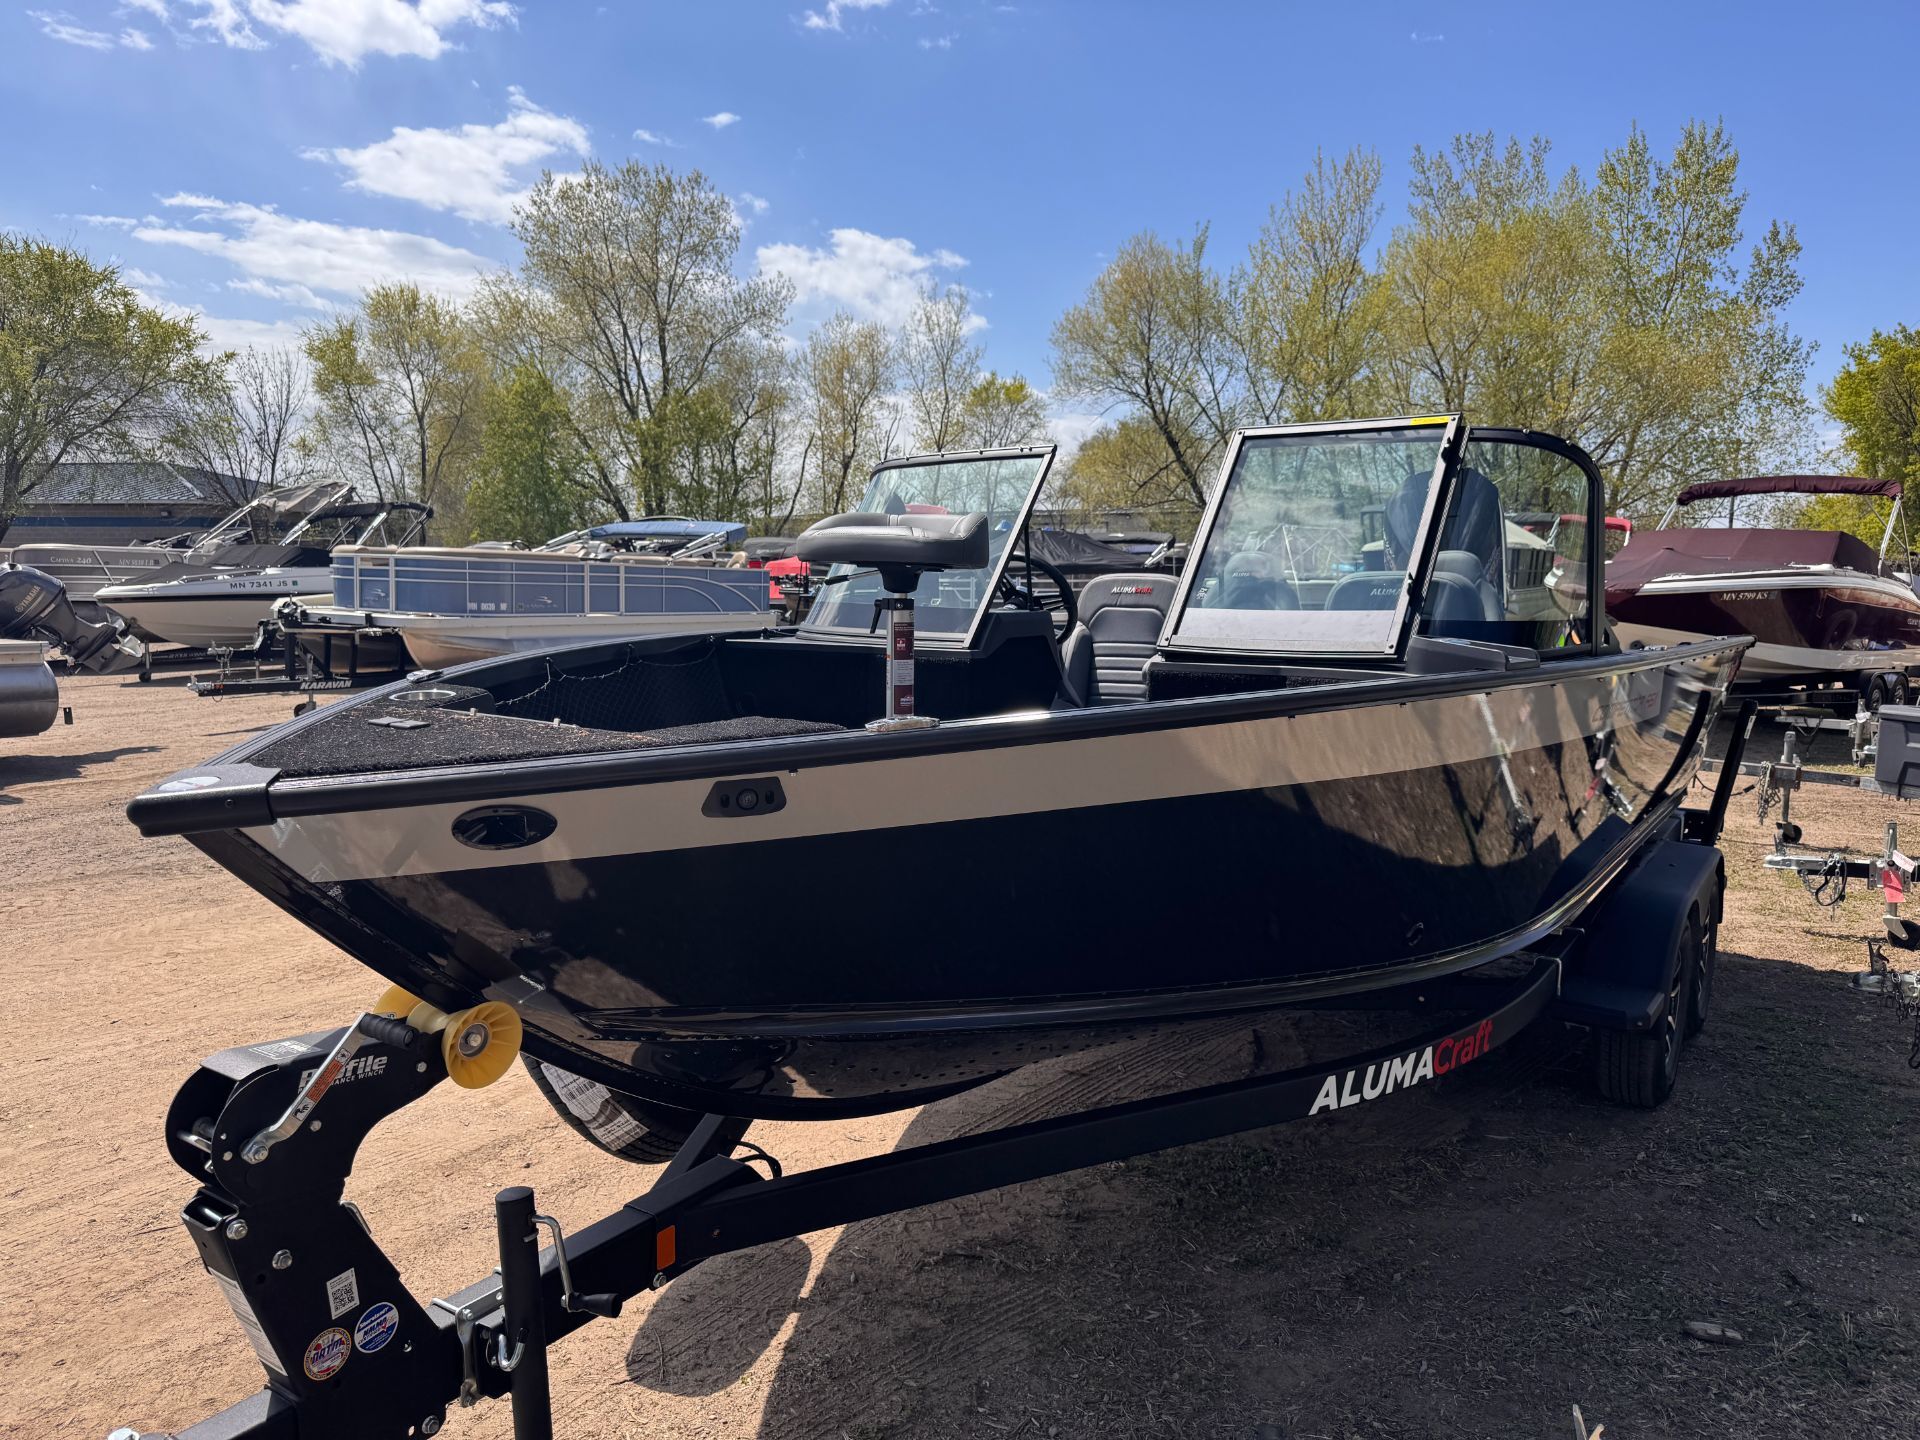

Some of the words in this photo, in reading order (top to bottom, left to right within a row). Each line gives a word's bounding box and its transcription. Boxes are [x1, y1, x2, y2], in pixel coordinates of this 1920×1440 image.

[21, 585, 41, 607] YAMAHA
[1721, 592, 1737, 600] MN
[300, 680, 352, 690] KARAVAN
[298, 1055, 388, 1088] Pfile
[358, 1069, 384, 1079] WINCH
